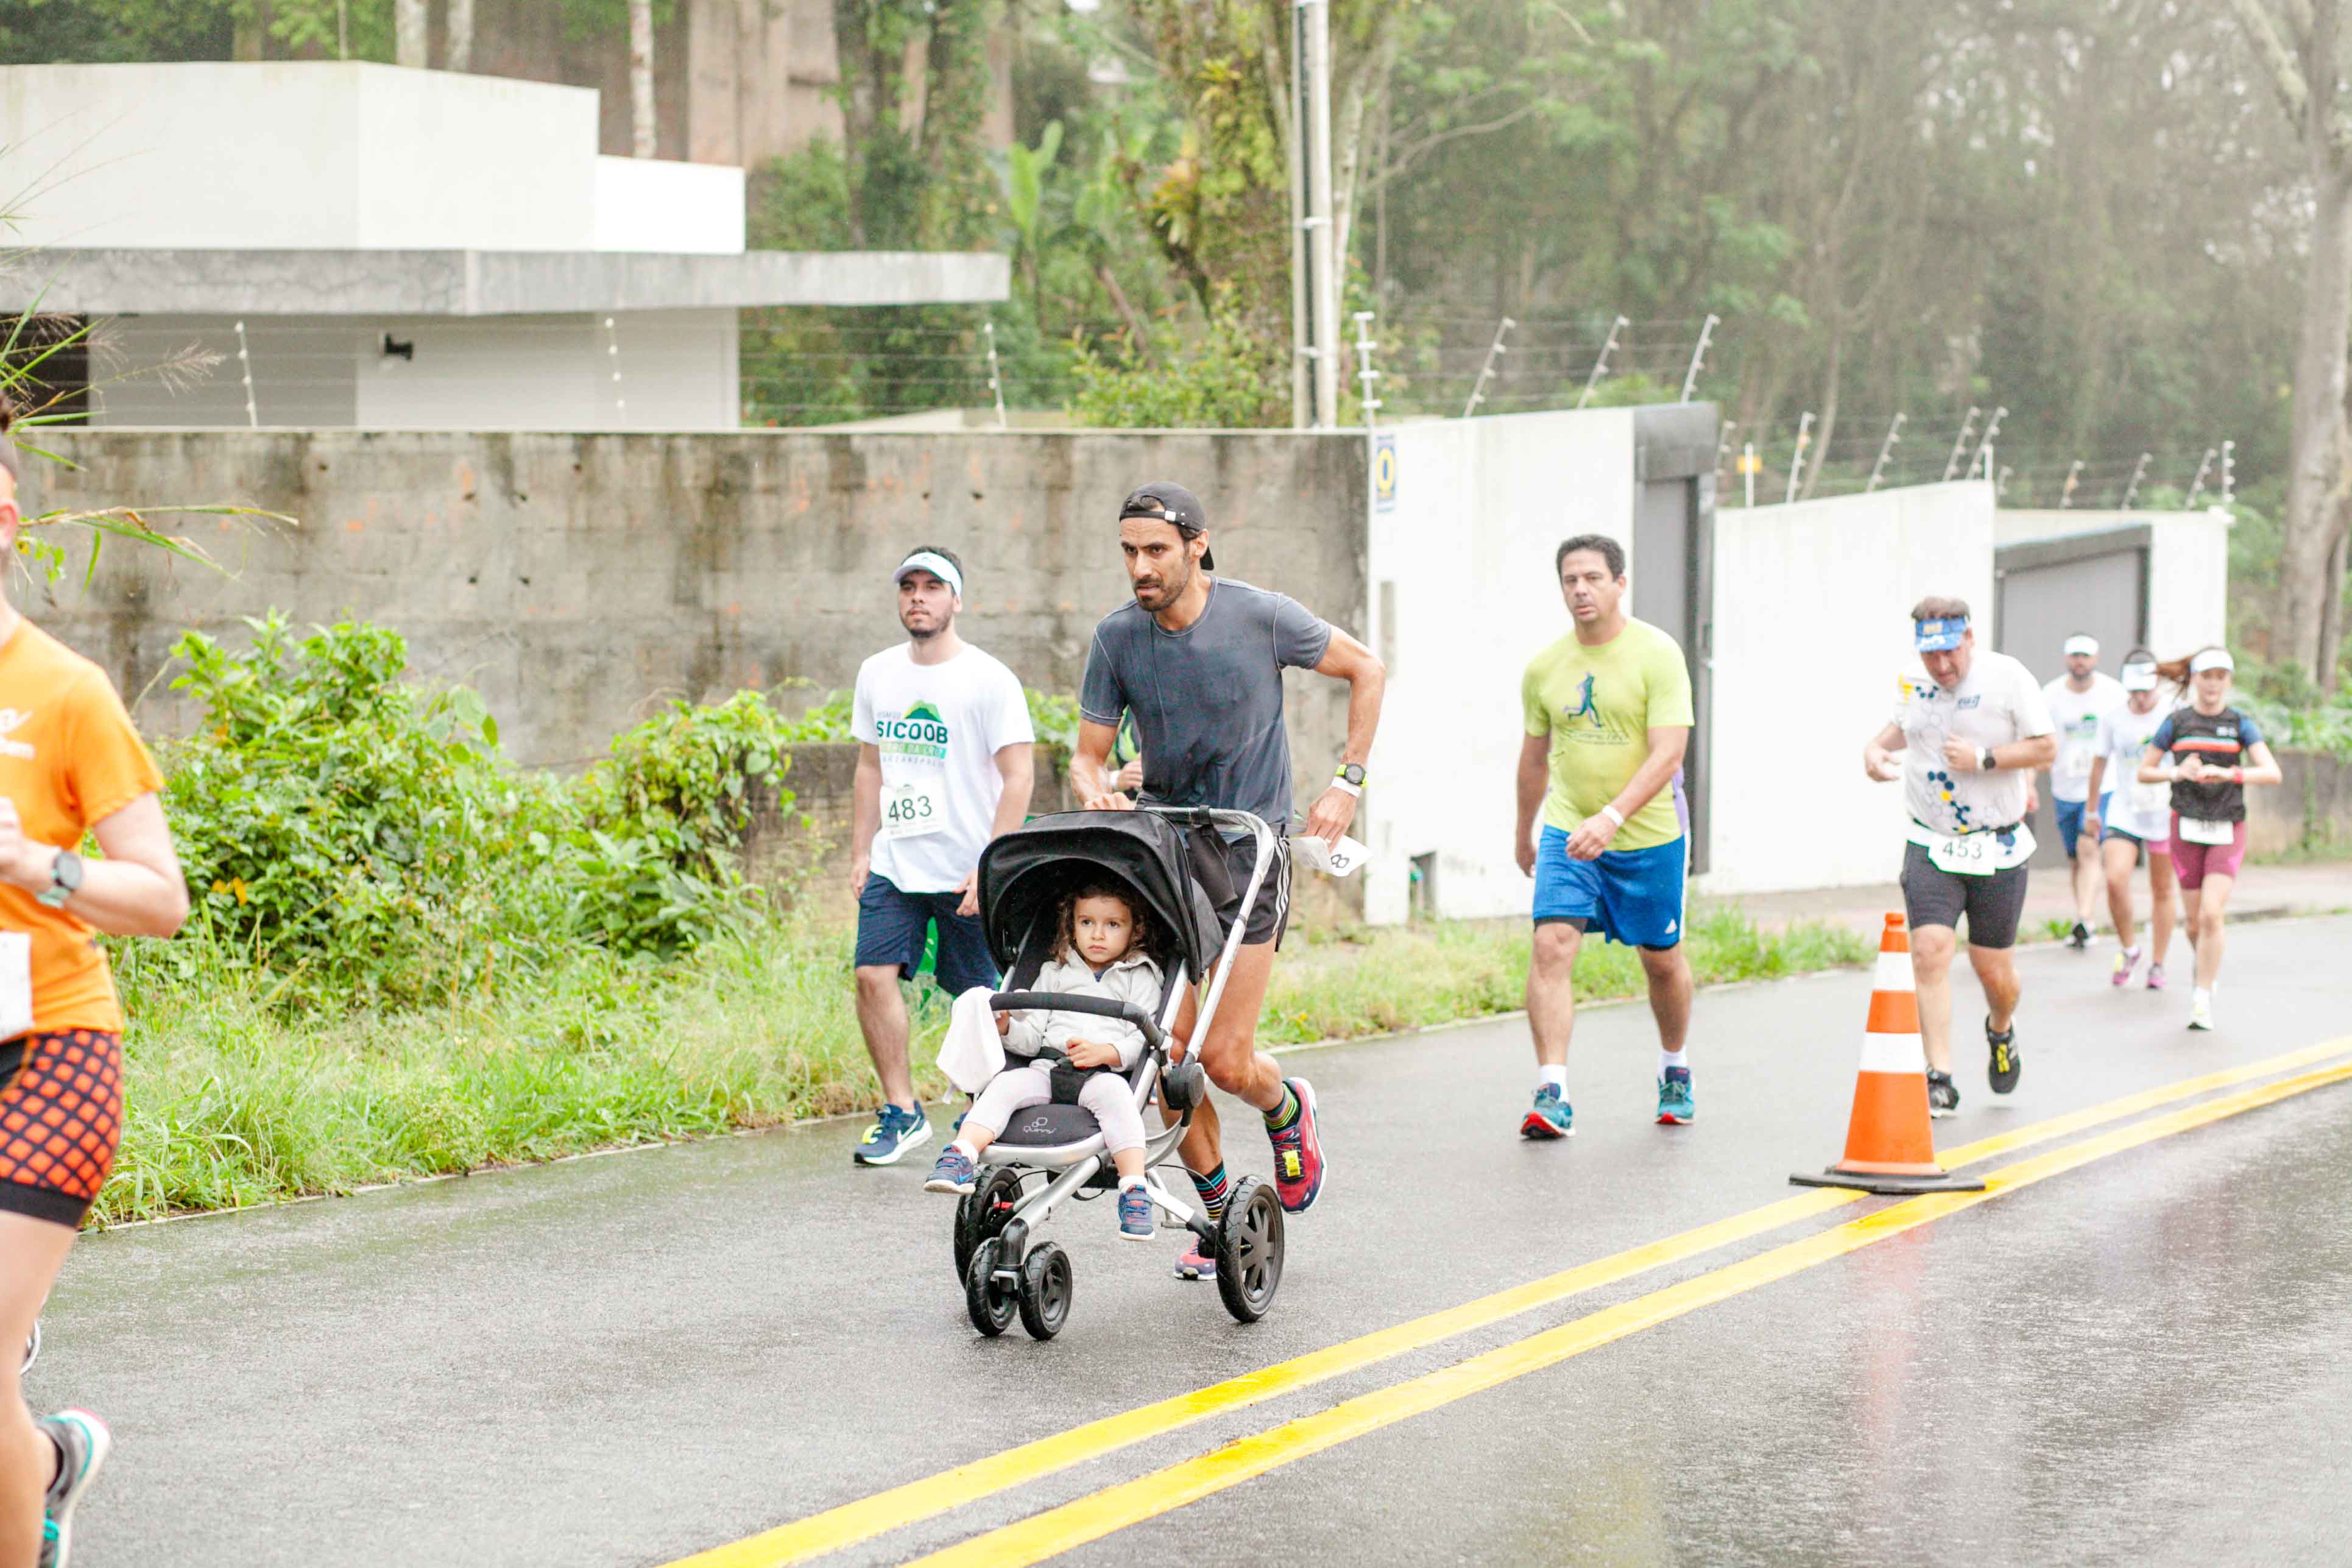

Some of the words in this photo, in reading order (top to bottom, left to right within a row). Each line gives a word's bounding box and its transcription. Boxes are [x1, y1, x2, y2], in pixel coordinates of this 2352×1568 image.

[877, 721, 948, 744] SICOOB
[888, 796, 933, 822] 483
[1942, 841, 1982, 860] 453
